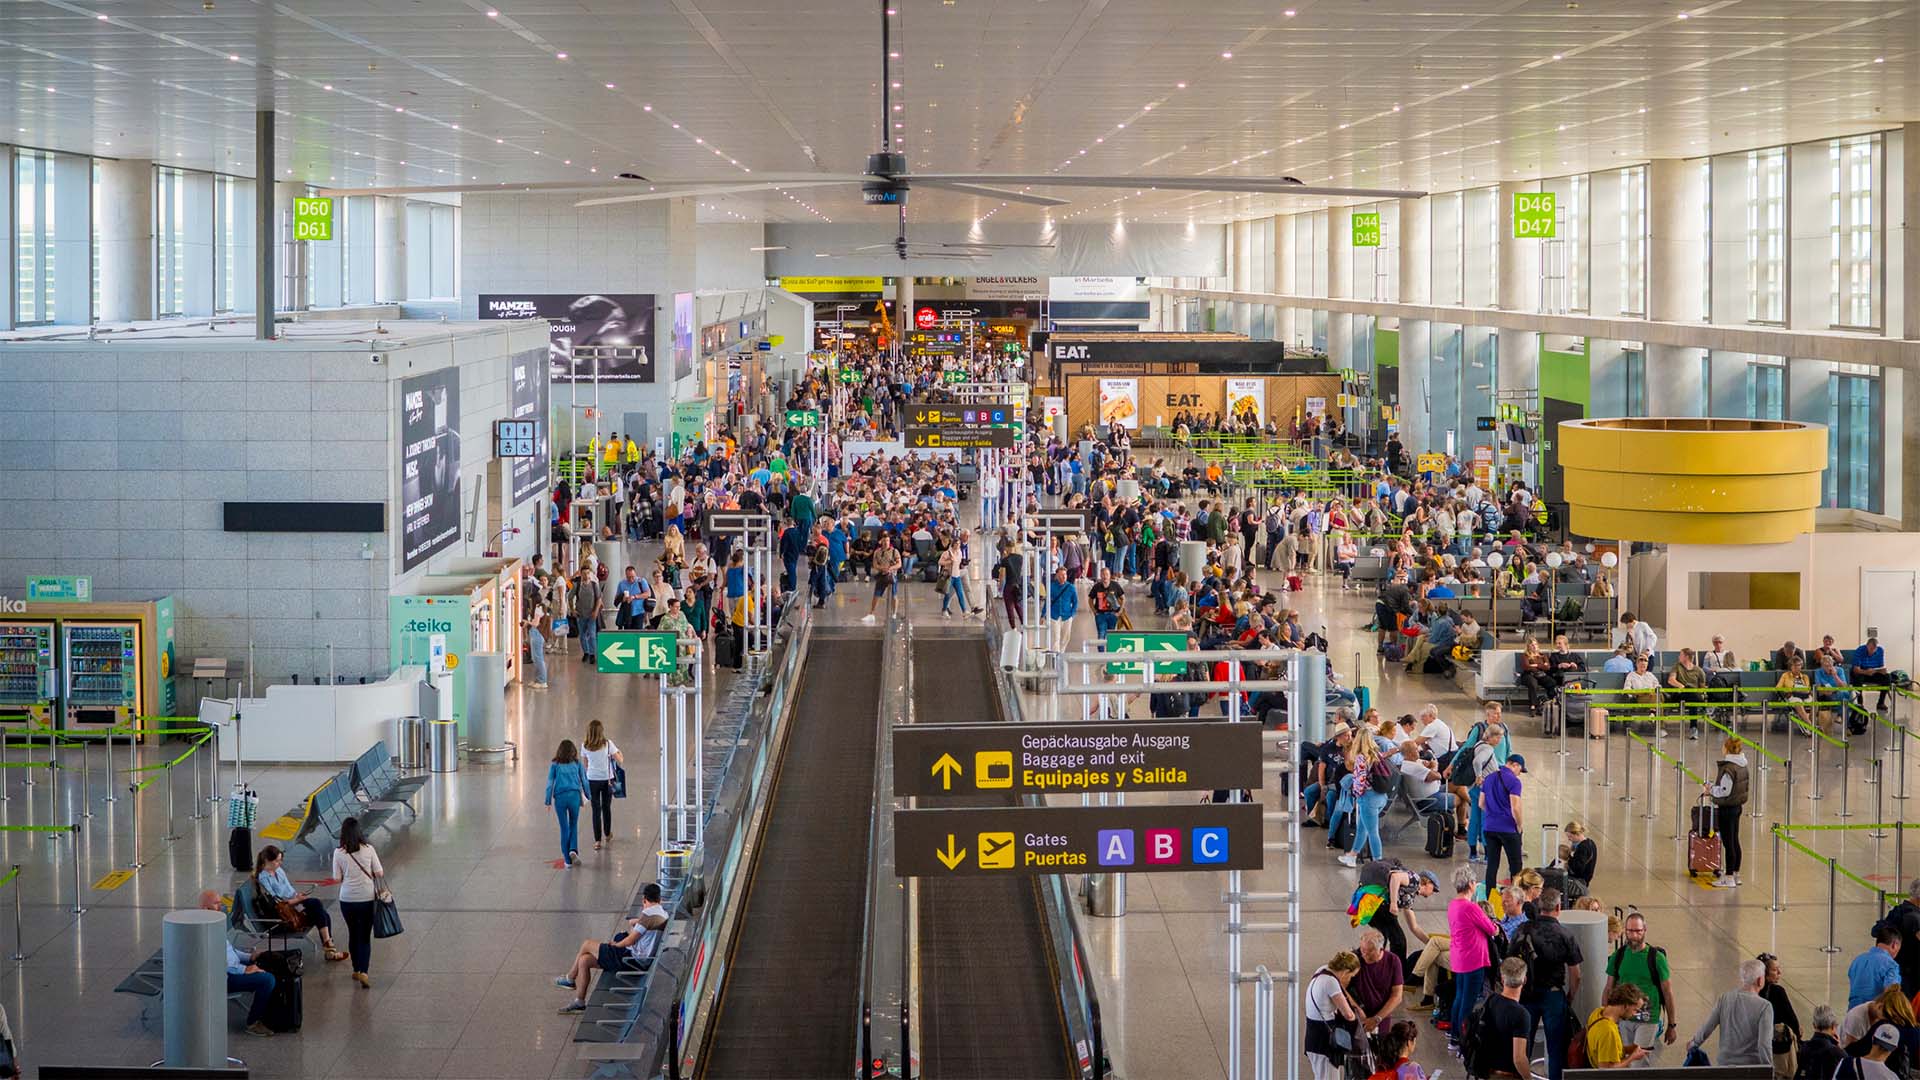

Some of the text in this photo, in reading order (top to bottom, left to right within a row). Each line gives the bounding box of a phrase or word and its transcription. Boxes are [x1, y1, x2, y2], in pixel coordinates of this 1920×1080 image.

[299, 201, 329, 216] D60
[1519, 196, 1552, 212] D46
[299, 221, 327, 237] D61
[1356, 215, 1377, 228] D44
[1519, 218, 1552, 234] D47
[1356, 232, 1378, 244] D45
[489, 301, 537, 311] MAMZEL
[1055, 346, 1091, 359] EAT.
[1166, 393, 1203, 407] EAT.
[966, 412, 973, 421] A
[981, 412, 988, 421] B
[994, 412, 1001, 421] C
[410, 618, 452, 632] teika
[1022, 733, 1190, 751] Gepäckausgabe Ausgang
[1022, 752, 1145, 769] Baggage and exit
[1023, 767, 1188, 788] Equipajes y Salida
[1024, 833, 1068, 847] Gates
[1106, 833, 1219, 860] A B C
[1024, 851, 1087, 866] Puertas
